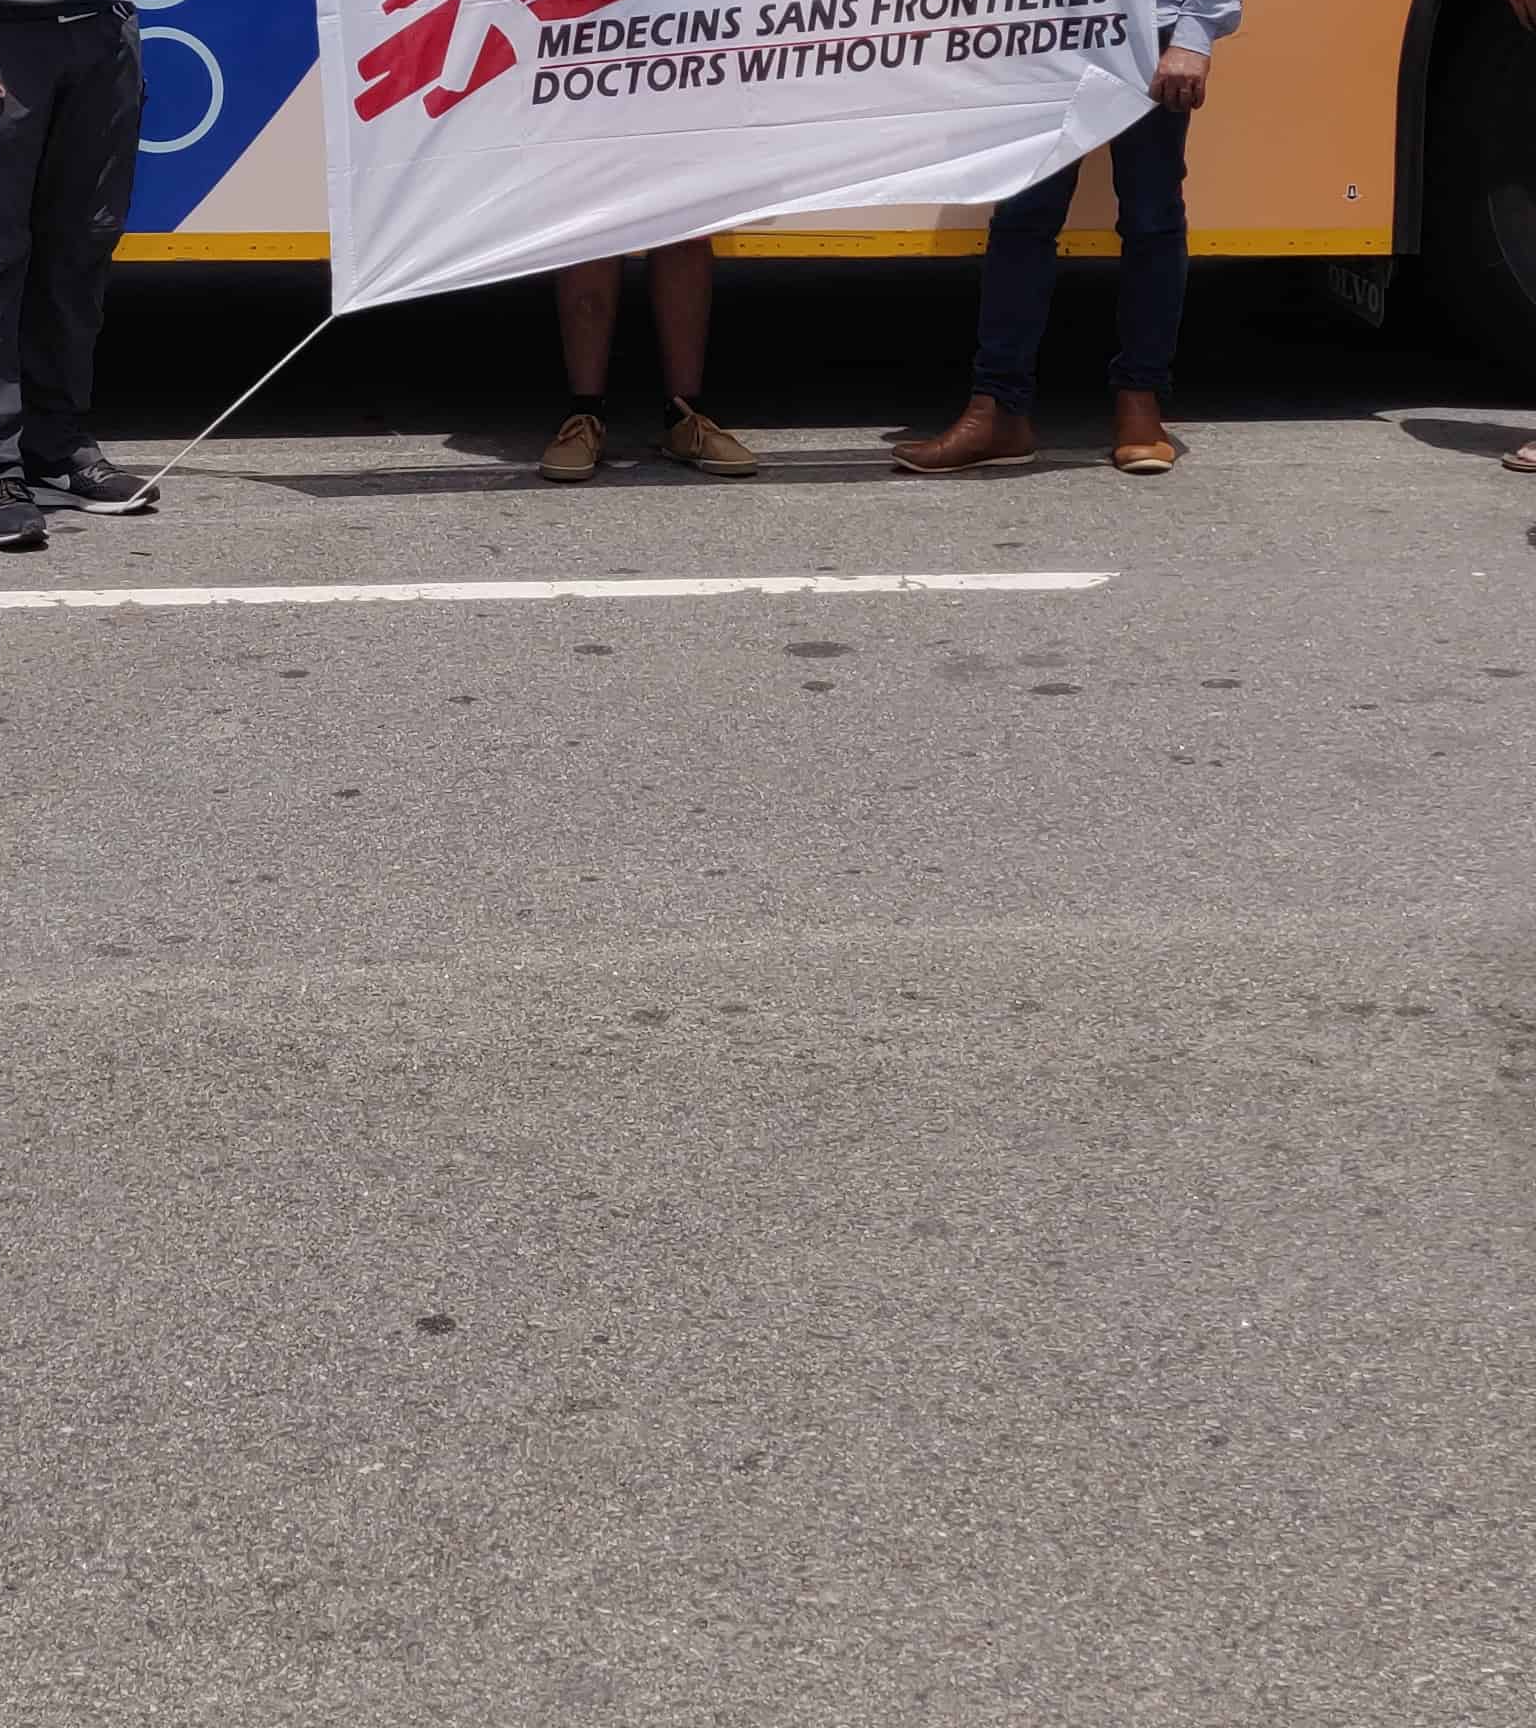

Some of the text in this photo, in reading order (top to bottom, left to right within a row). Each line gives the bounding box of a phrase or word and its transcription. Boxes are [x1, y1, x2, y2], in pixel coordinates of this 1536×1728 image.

[532, 13, 1128, 105] DOCTORS WITHOUT BORDERS
[536, 6, 742, 59] MEDECINS
